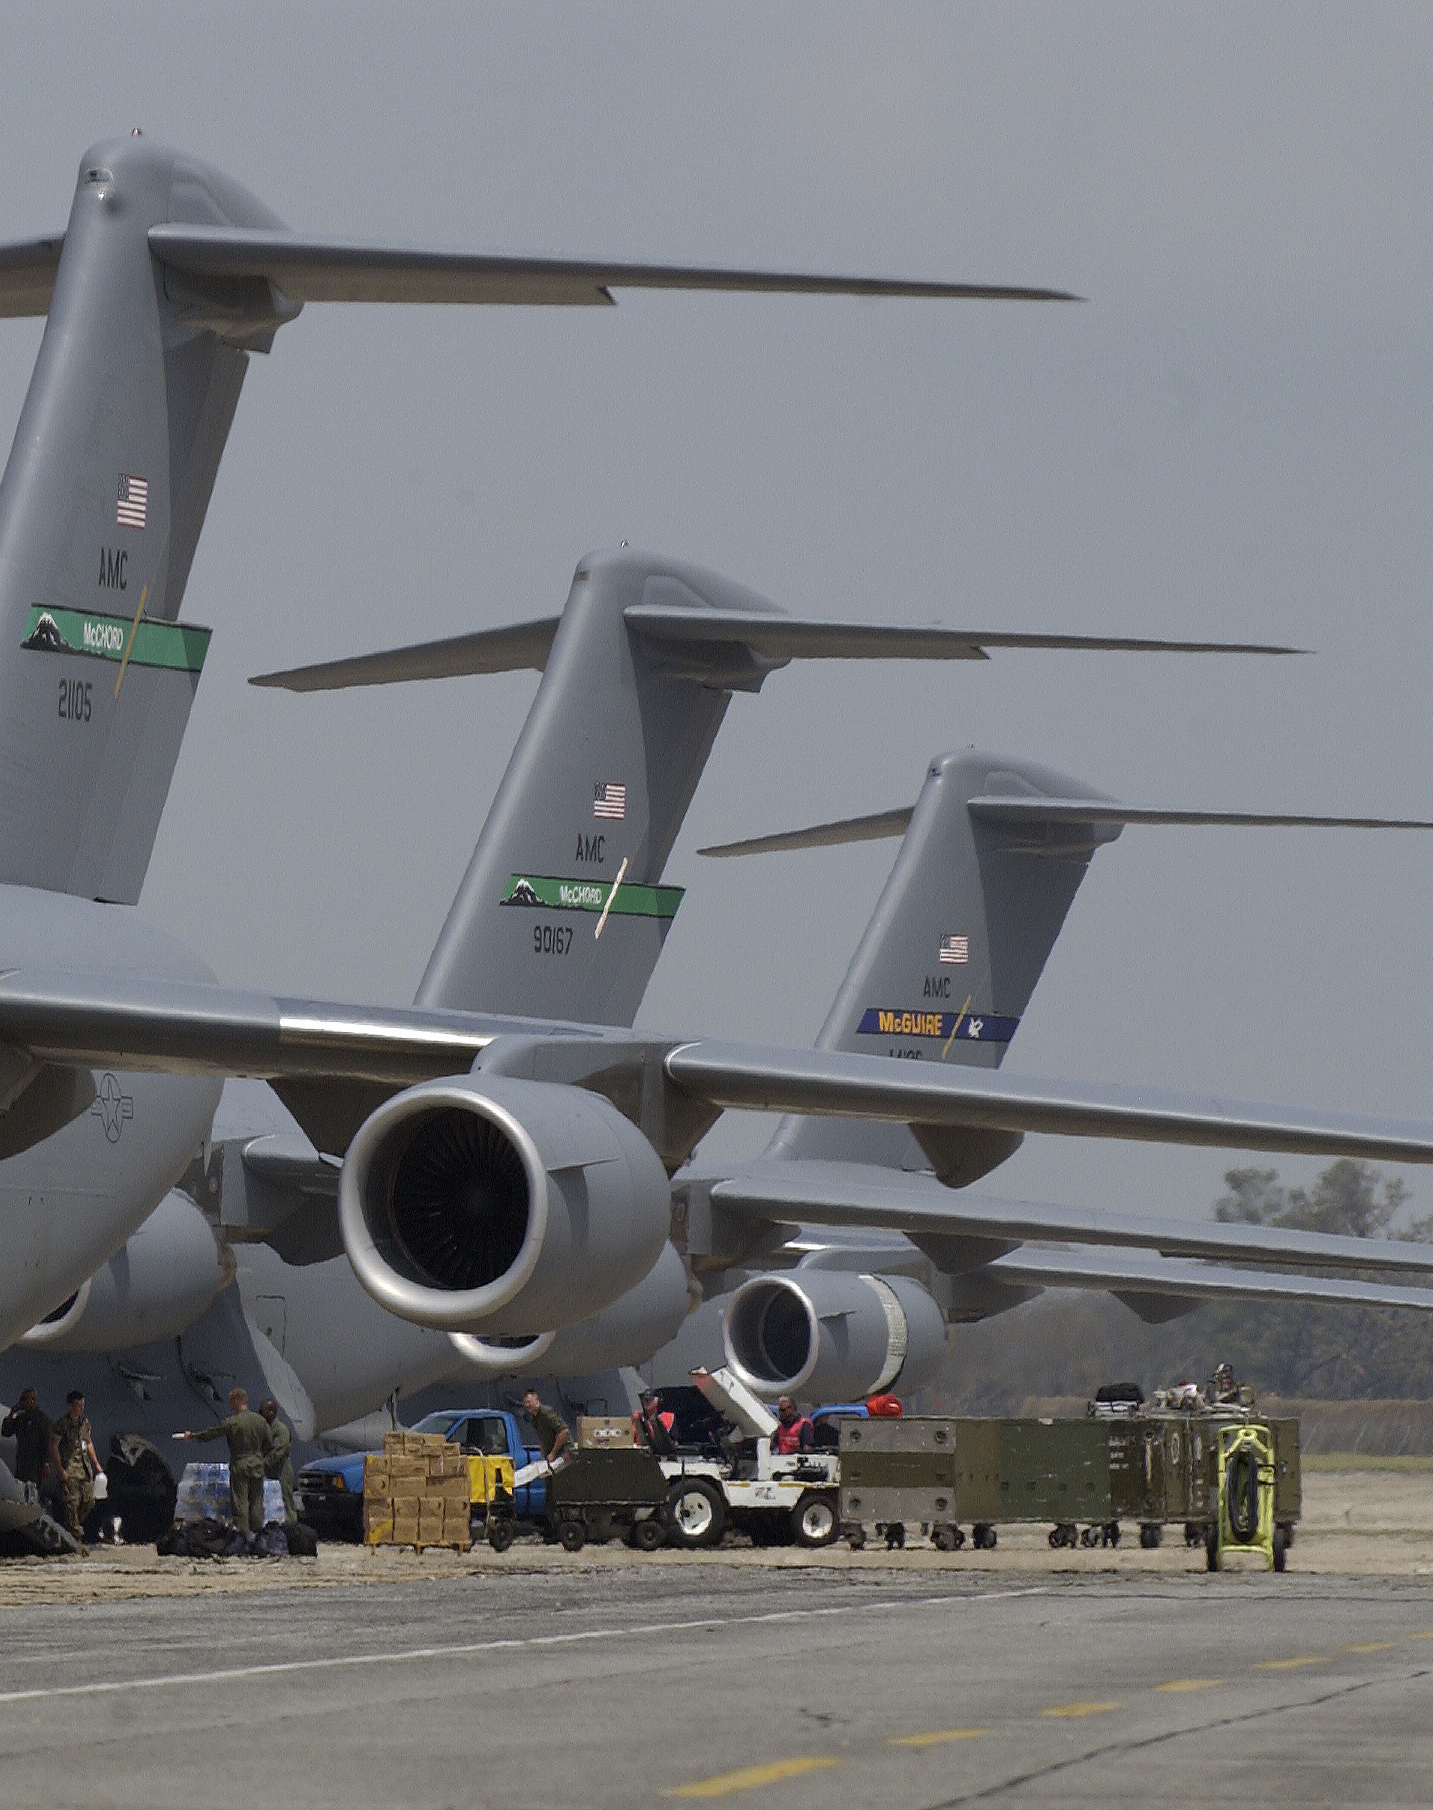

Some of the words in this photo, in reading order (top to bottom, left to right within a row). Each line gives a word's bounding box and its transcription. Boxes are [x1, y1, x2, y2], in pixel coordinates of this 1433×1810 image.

[98, 546, 128, 590] AMC
[82, 621, 124, 651] McCHORD
[58, 678, 93, 722] 21105
[576, 833, 605, 863] AMC
[559, 885, 602, 904] McCHORD
[534, 926, 573, 954] 90167
[923, 976, 950, 998] AMC
[878, 1010, 943, 1036] McGUIRE
